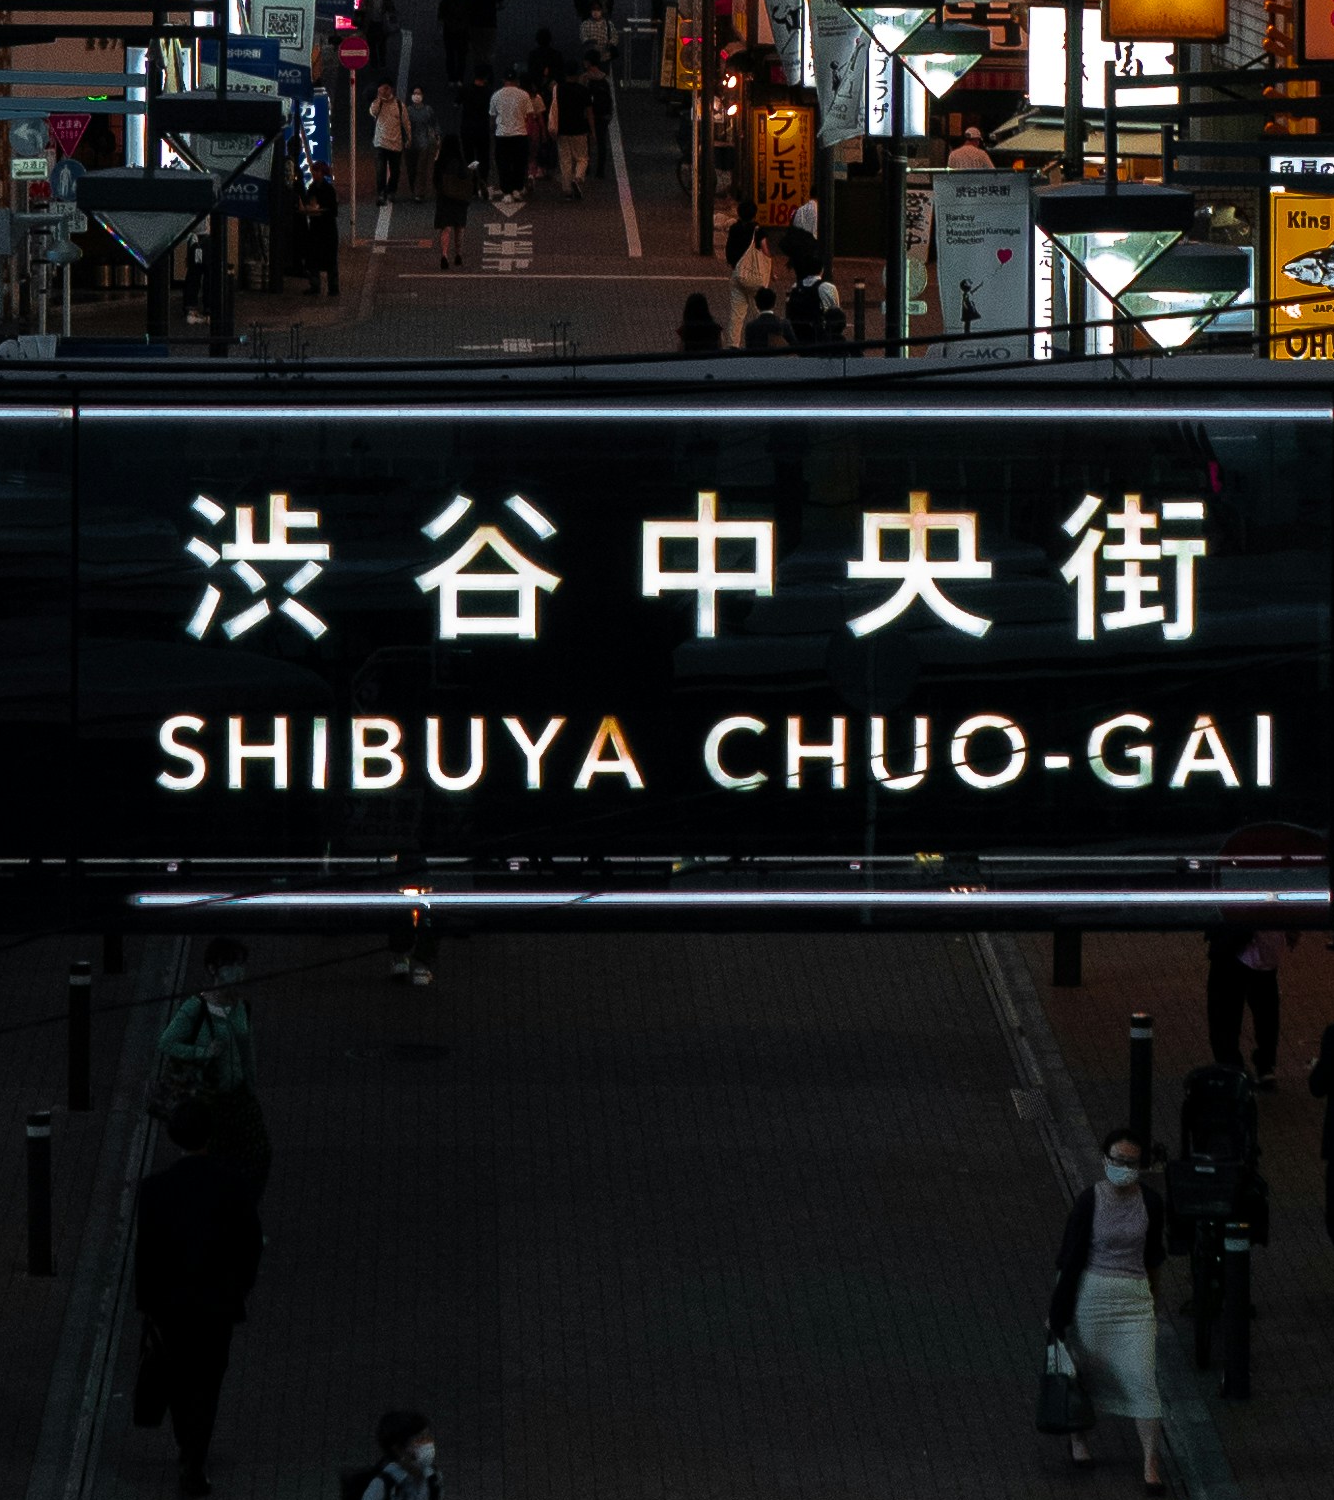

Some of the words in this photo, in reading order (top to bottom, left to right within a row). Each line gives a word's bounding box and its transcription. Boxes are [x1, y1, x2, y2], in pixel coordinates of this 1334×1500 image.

[955, 184, 1011, 198] 渋谷中央街
[1287, 211, 1330, 230] King
[186, 491, 1207, 642] 渋谷中央街
[157, 714, 645, 792] SHIBUYA
[704, 714, 1274, 792] CHUO-GAI
